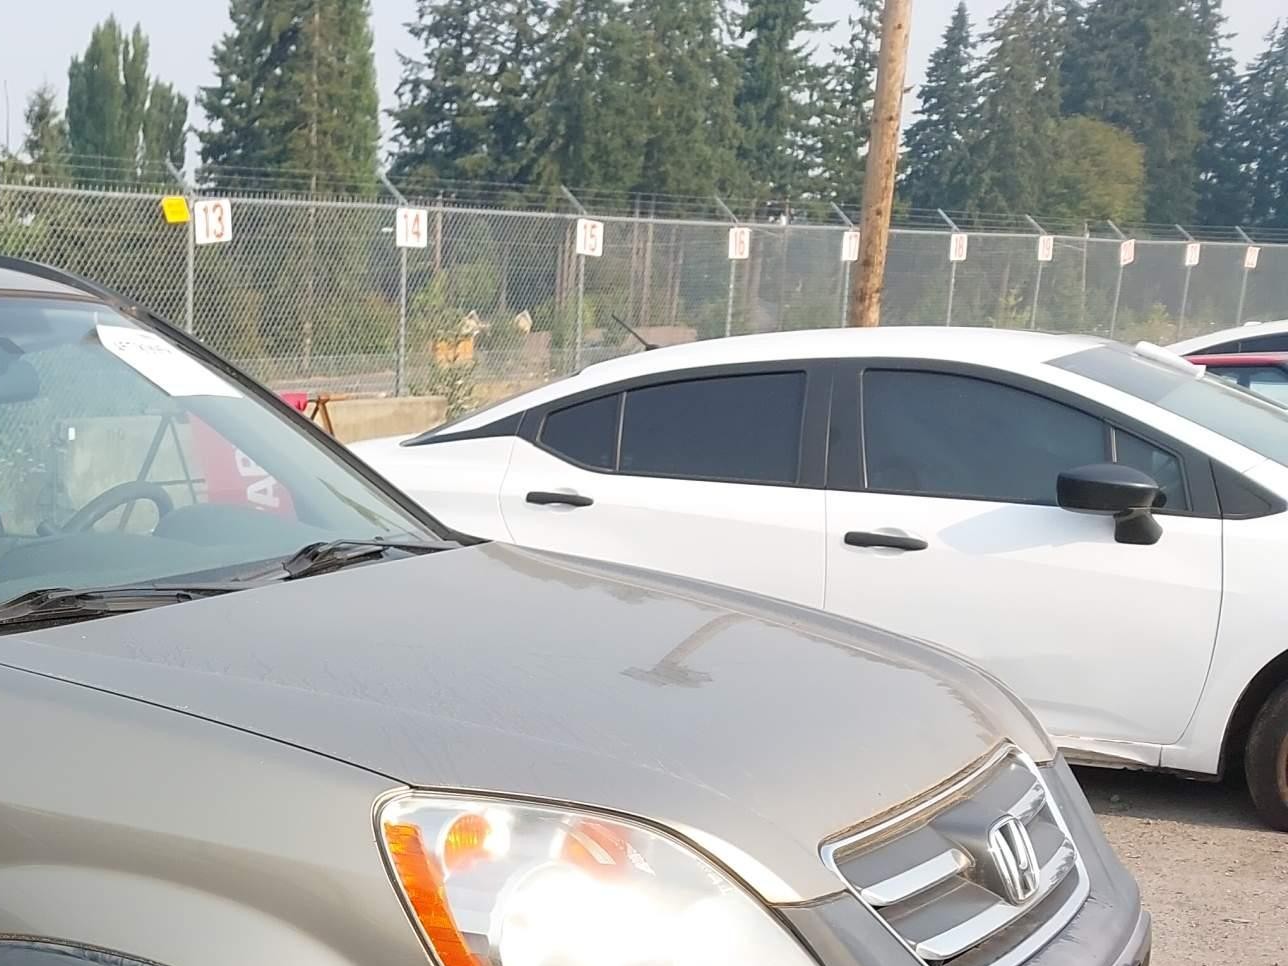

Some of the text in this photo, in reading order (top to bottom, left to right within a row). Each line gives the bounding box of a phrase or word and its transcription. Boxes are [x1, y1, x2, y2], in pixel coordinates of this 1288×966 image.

[202, 203, 225, 239] 13
[403, 213, 422, 243] 14
[583, 222, 598, 252] 15
